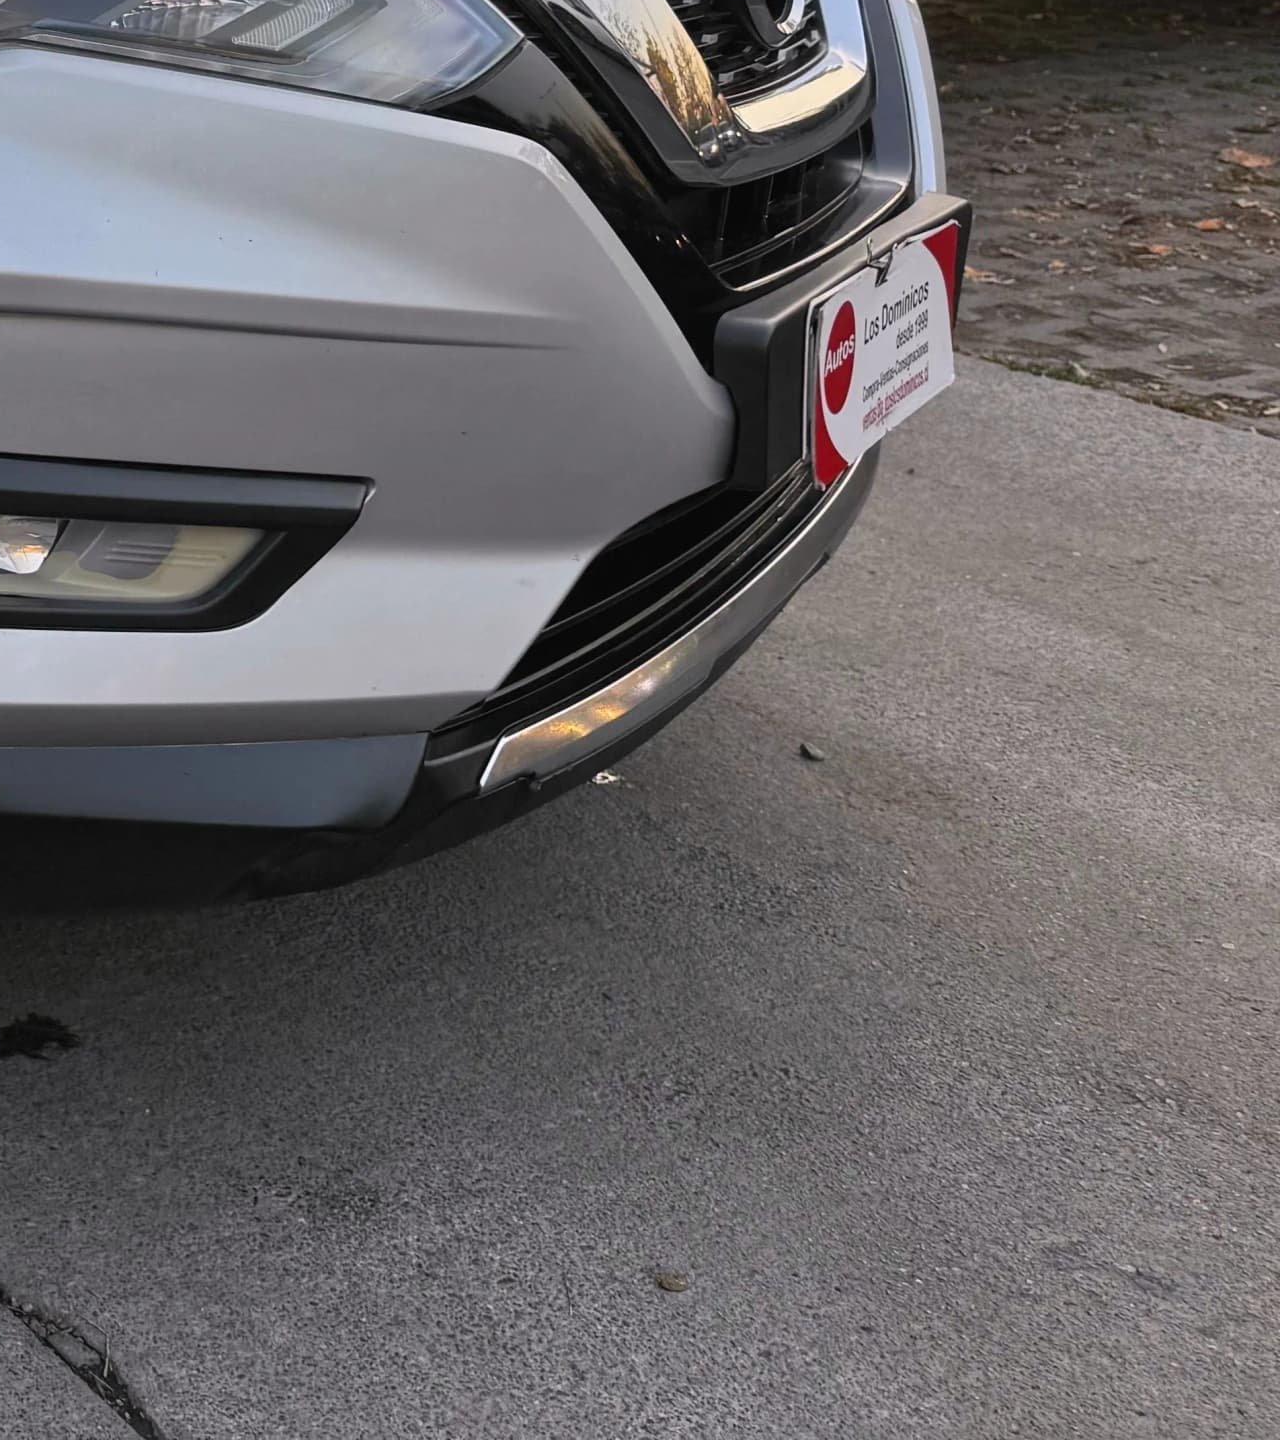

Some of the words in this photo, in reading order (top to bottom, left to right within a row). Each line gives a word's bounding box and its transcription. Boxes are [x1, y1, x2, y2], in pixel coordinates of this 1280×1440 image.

[864, 315, 880, 346] Los
[881, 281, 929, 331] Dominicos
[824, 333, 855, 378] Autos
